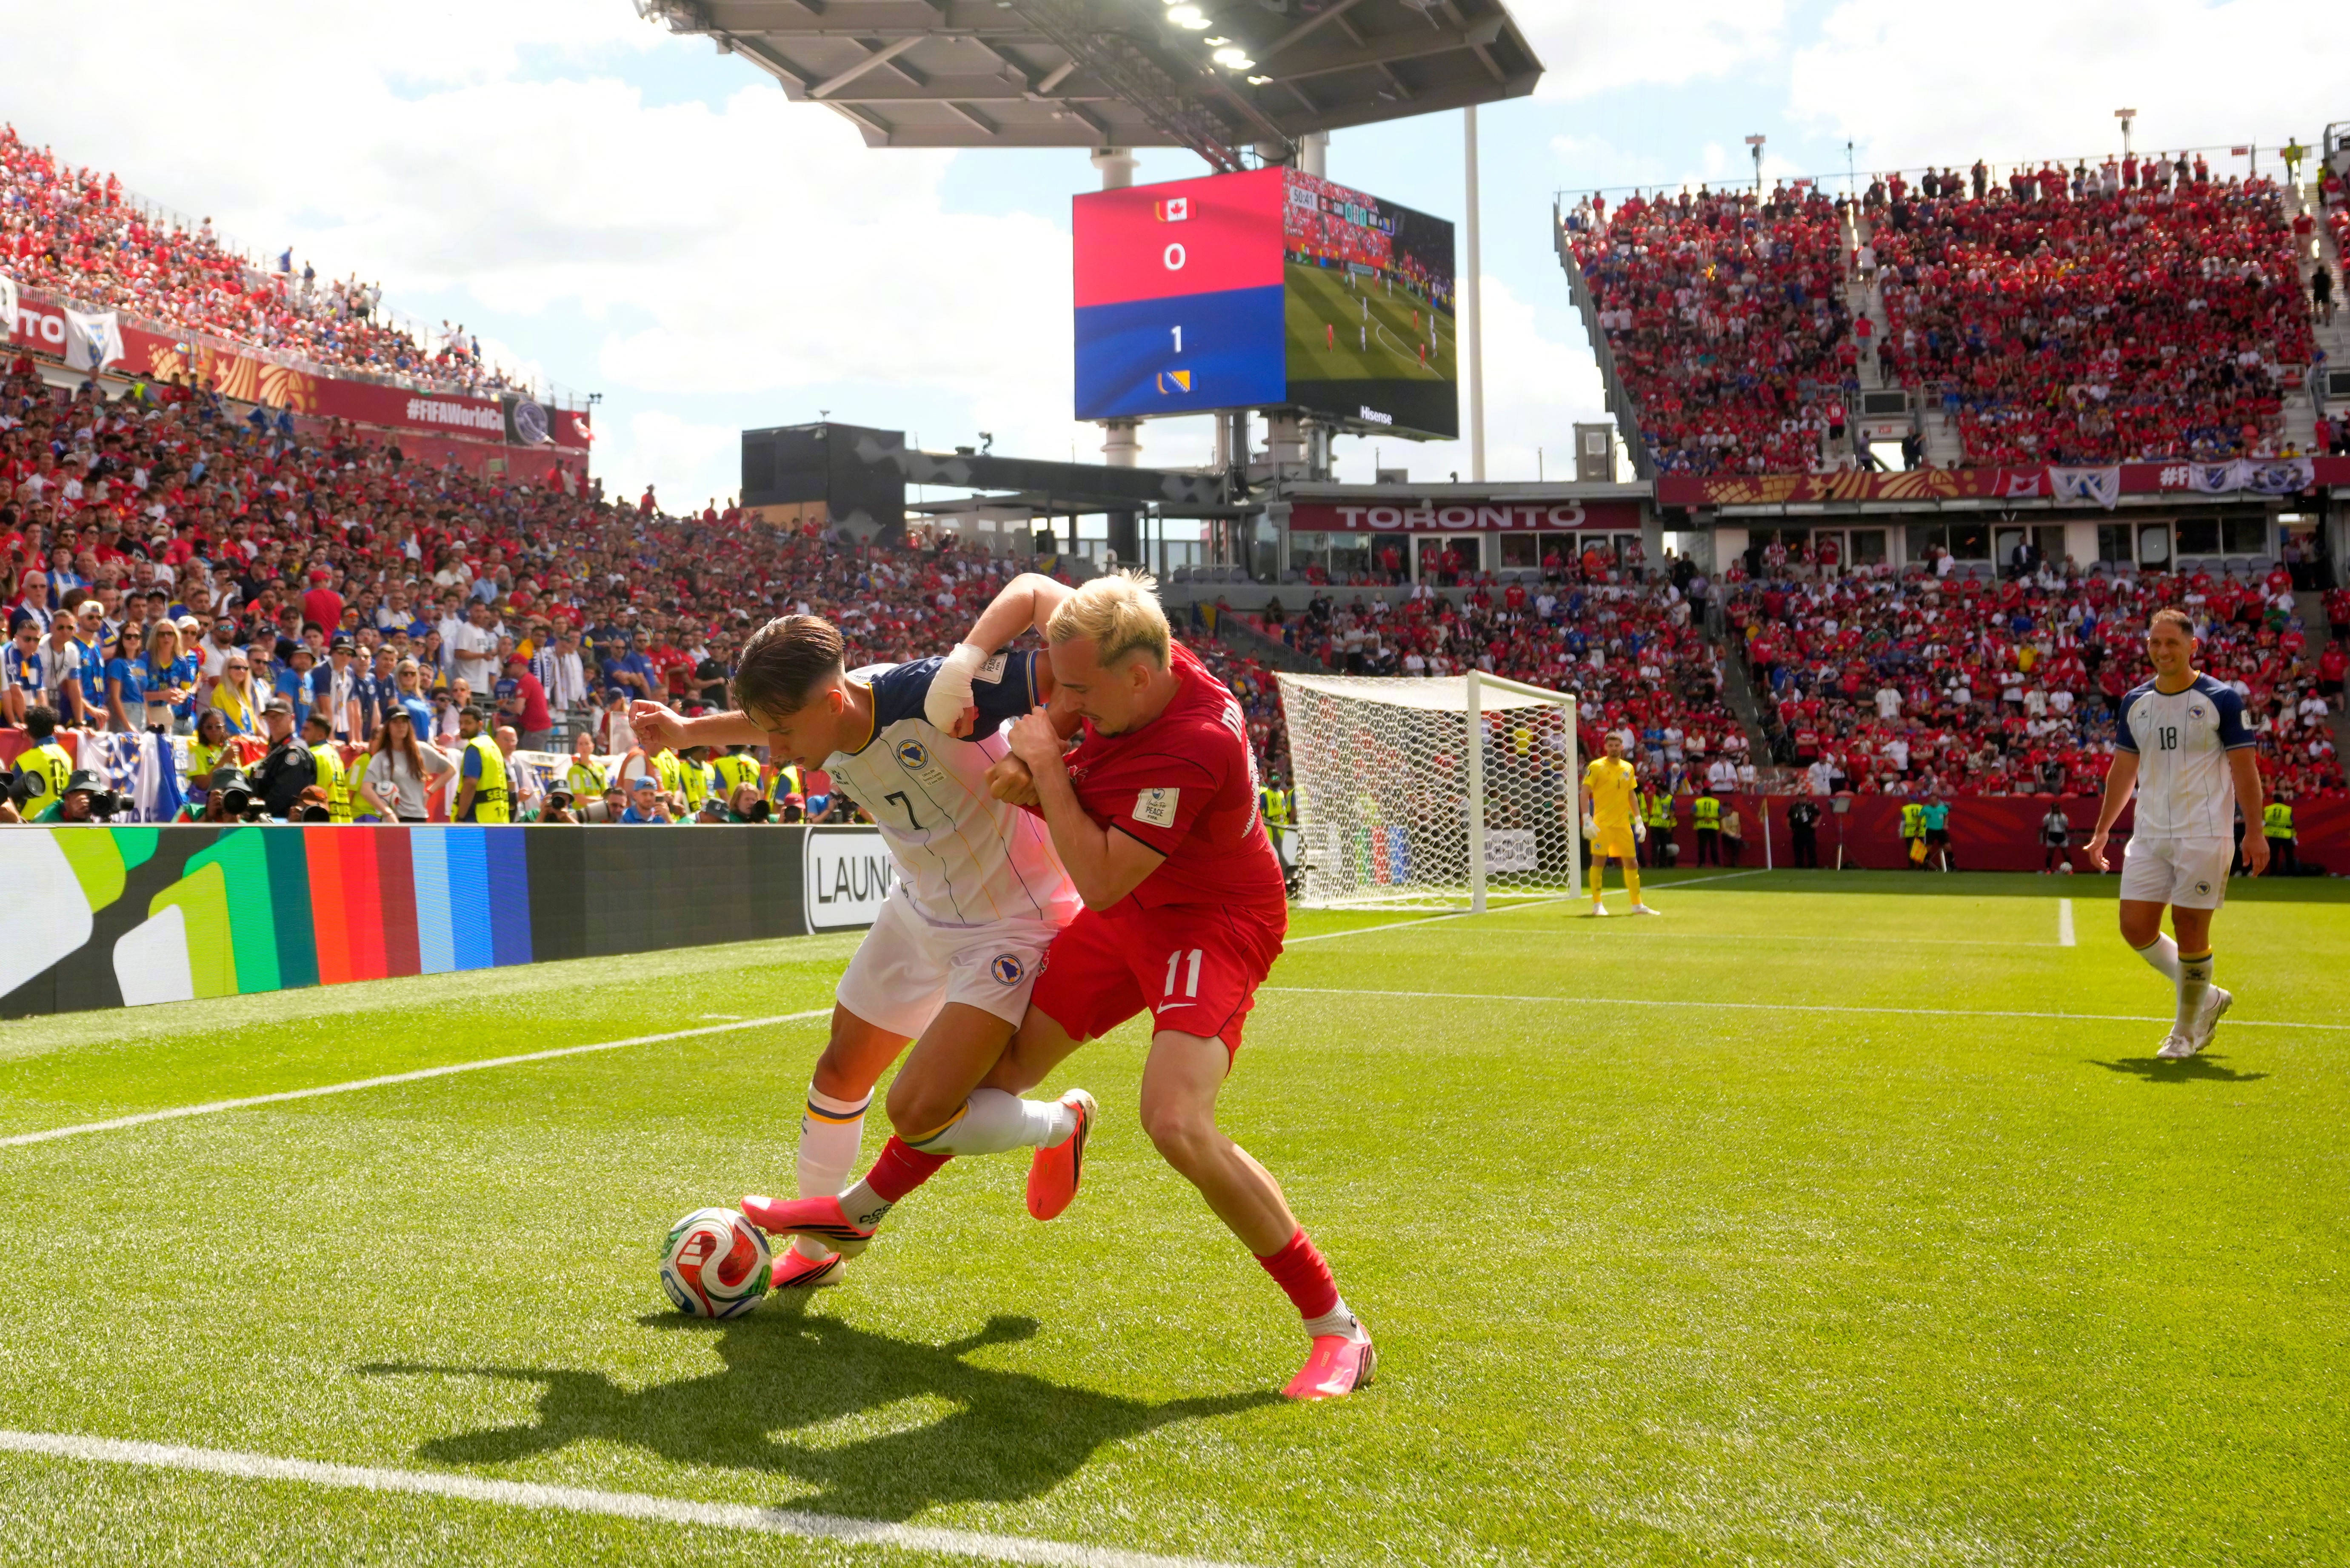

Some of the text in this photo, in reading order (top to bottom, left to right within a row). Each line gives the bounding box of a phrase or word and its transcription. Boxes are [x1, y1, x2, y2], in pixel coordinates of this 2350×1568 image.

[1294, 189, 1313, 206] 50:41
[1348, 207, 1351, 218] 0
[1362, 212, 1365, 223] 1
[1163, 243, 1186, 270] 0
[1171, 325, 1182, 353] 1
[1360, 405, 1392, 426] Hisense
[1336, 506, 1586, 529] TORONTO
[987, 658, 997, 672] PEACE
[2159, 726, 2177, 750] 18
[884, 791, 925, 830] 7
[1145, 806, 1164, 817] PEACE
[1146, 799, 1159, 807] Unite
[1164, 949, 1203, 998] 11
